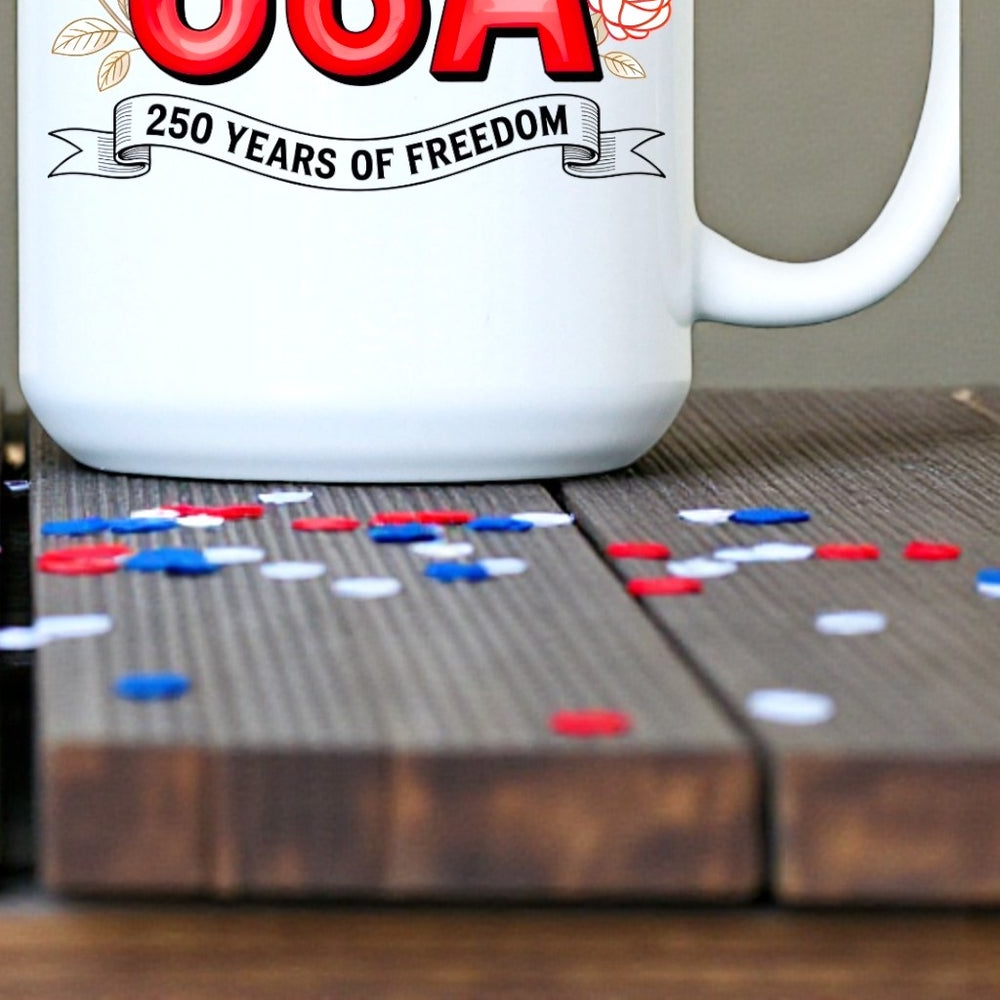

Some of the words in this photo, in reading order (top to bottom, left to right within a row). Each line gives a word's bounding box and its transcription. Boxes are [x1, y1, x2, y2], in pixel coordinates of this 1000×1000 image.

[146, 103, 213, 145] 250
[227, 120, 337, 180] YEARS
[351, 147, 394, 181] OF
[405, 104, 569, 175] FREEDOM
